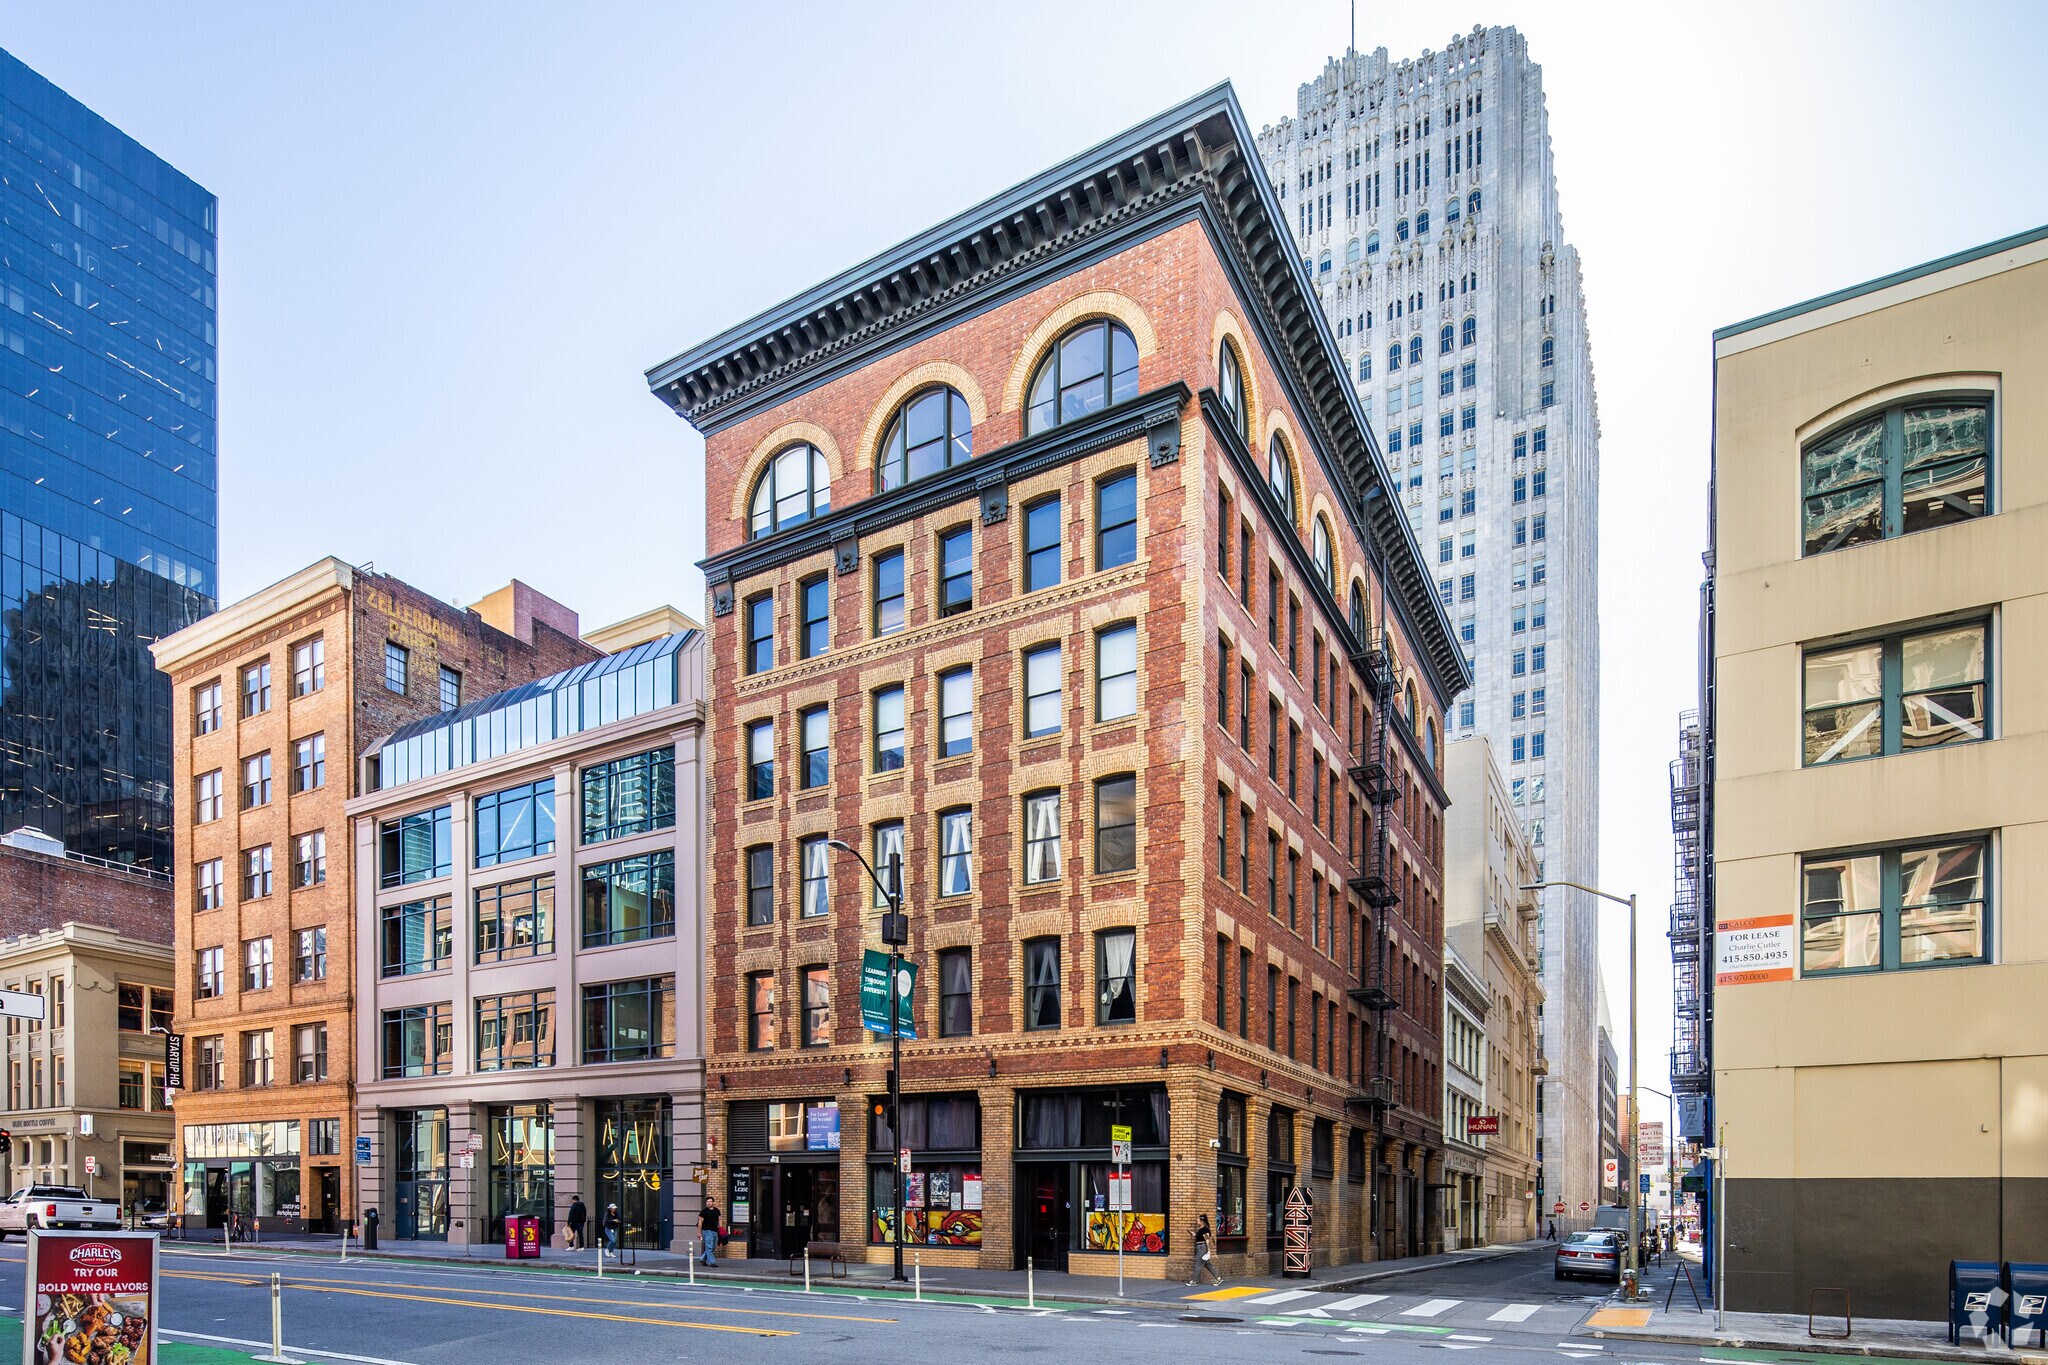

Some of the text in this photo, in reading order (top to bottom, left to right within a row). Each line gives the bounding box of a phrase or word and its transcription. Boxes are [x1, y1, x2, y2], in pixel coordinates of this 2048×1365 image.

[364, 584, 459, 647] ZELLERBACH
[1728, 920, 1755, 928] CALCO
[1730, 931, 1780, 942] FOR LEASE
[1722, 951, 1788, 963] 415.850.4935
[865, 966, 887, 977] LEARNING
[864, 976, 886, 986] THROUGH
[1718, 973, 1769, 983] 415.970.0000
[863, 986, 887, 996] DIVERSITY
[170, 1036, 180, 1086] STARTUP HQ
[39, 1118, 56, 1126] COFFEE
[69, 1247, 122, 1261] CHARLEYS
[73, 1268, 118, 1277] TRY OUR
[38, 1282, 149, 1292] BOLD WING FLAVORS
